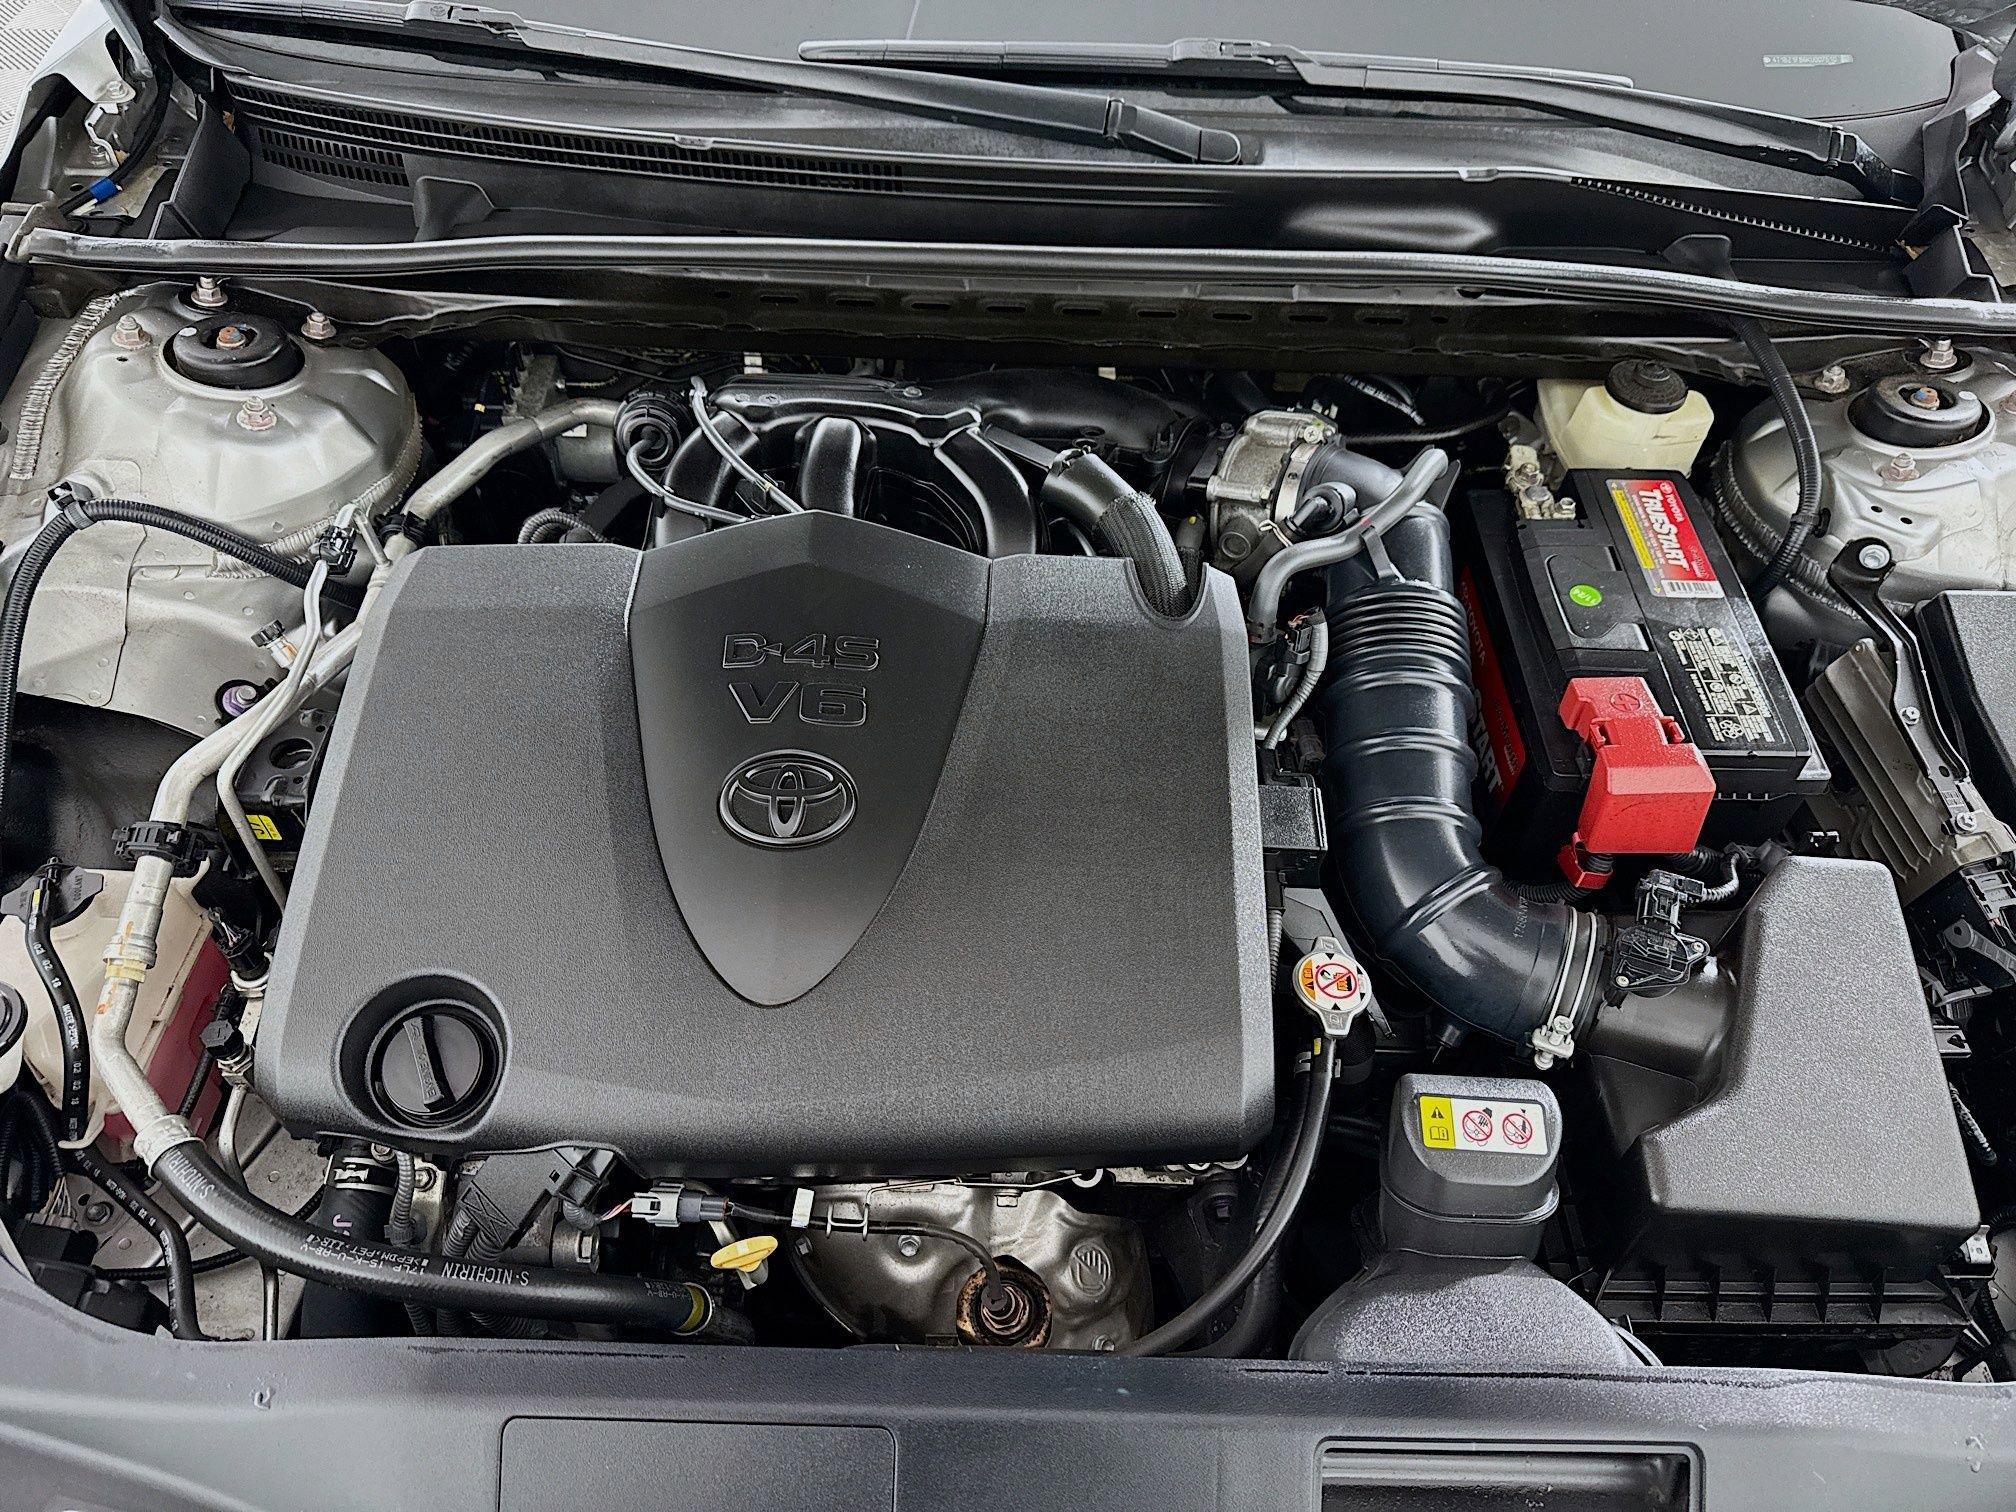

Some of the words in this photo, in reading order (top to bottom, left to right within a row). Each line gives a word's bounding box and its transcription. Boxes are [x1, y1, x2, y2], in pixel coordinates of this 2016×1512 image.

[1664, 492, 1685, 522] TOYOTA
[728, 680, 867, 727] V6
[419, 1061, 437, 1098] ENGINE
